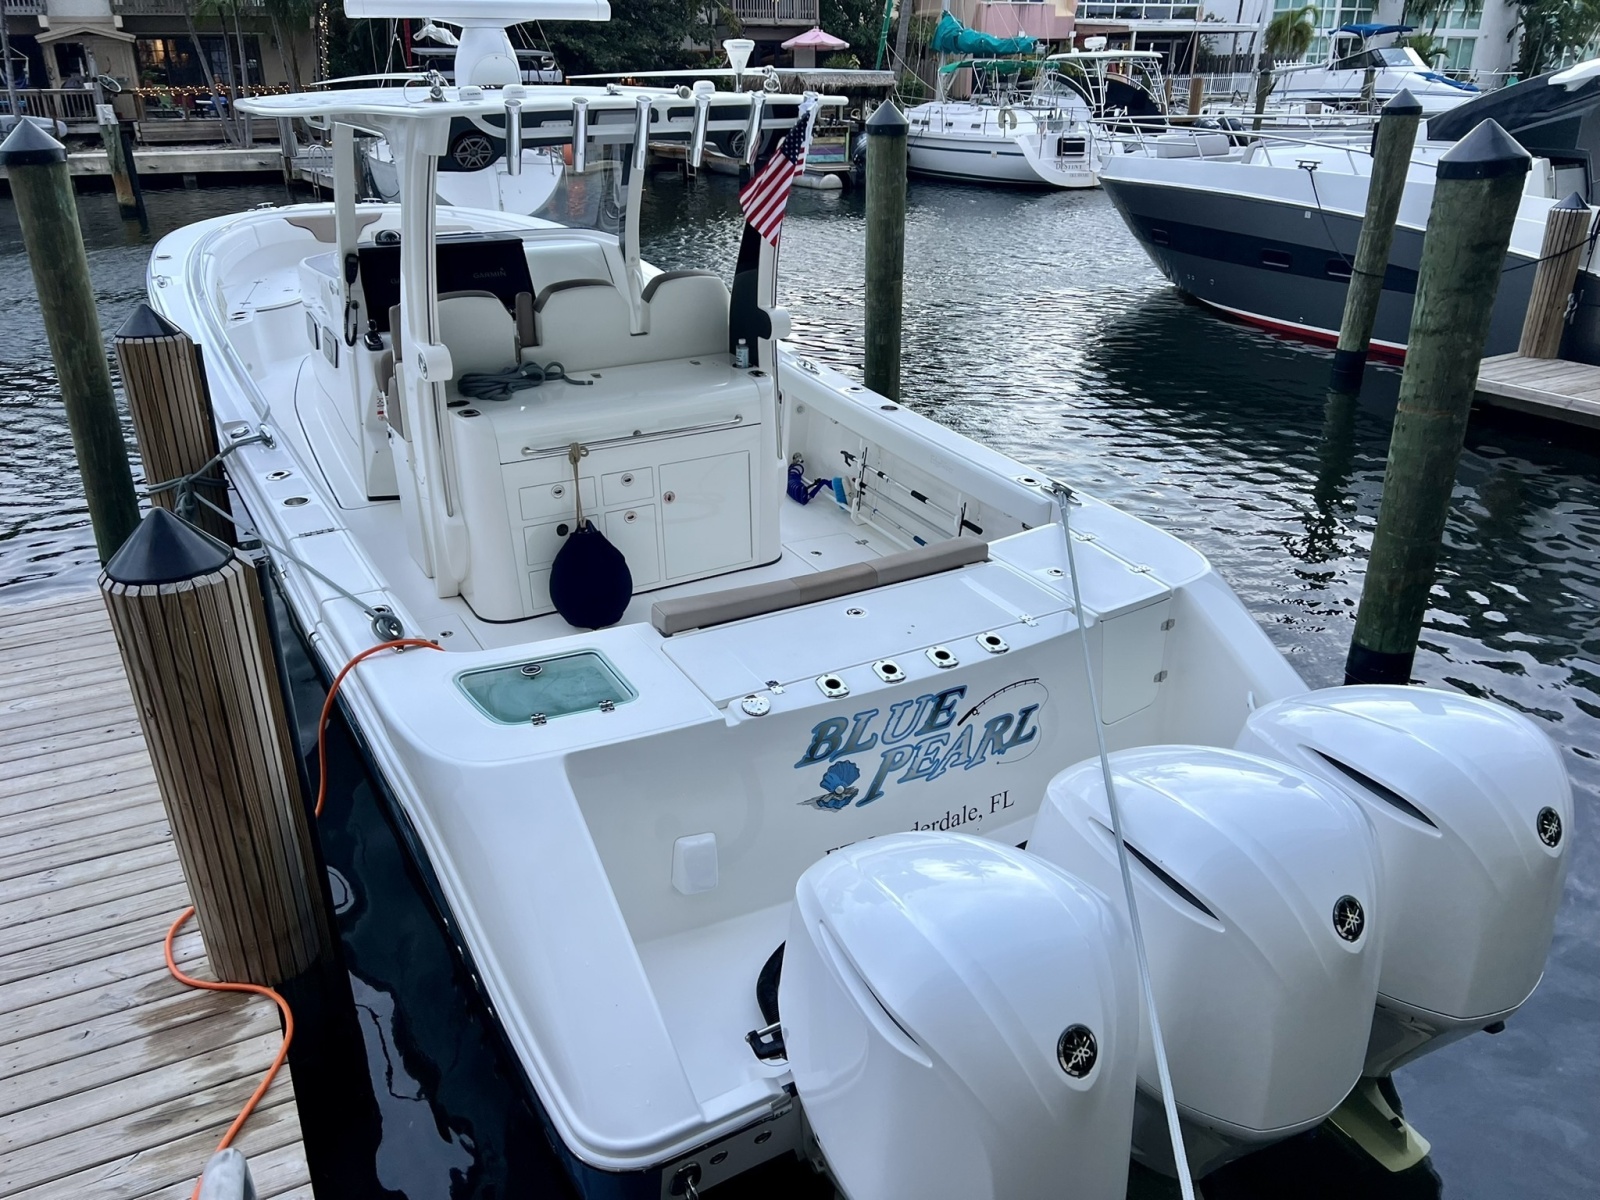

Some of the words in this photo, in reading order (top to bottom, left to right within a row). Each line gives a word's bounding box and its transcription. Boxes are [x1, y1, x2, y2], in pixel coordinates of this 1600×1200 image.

[473, 268, 507, 279] GARMIN
[794, 685, 967, 769] BLUE
[855, 703, 1040, 808] PEARL
[989, 790, 1015, 814] FL
